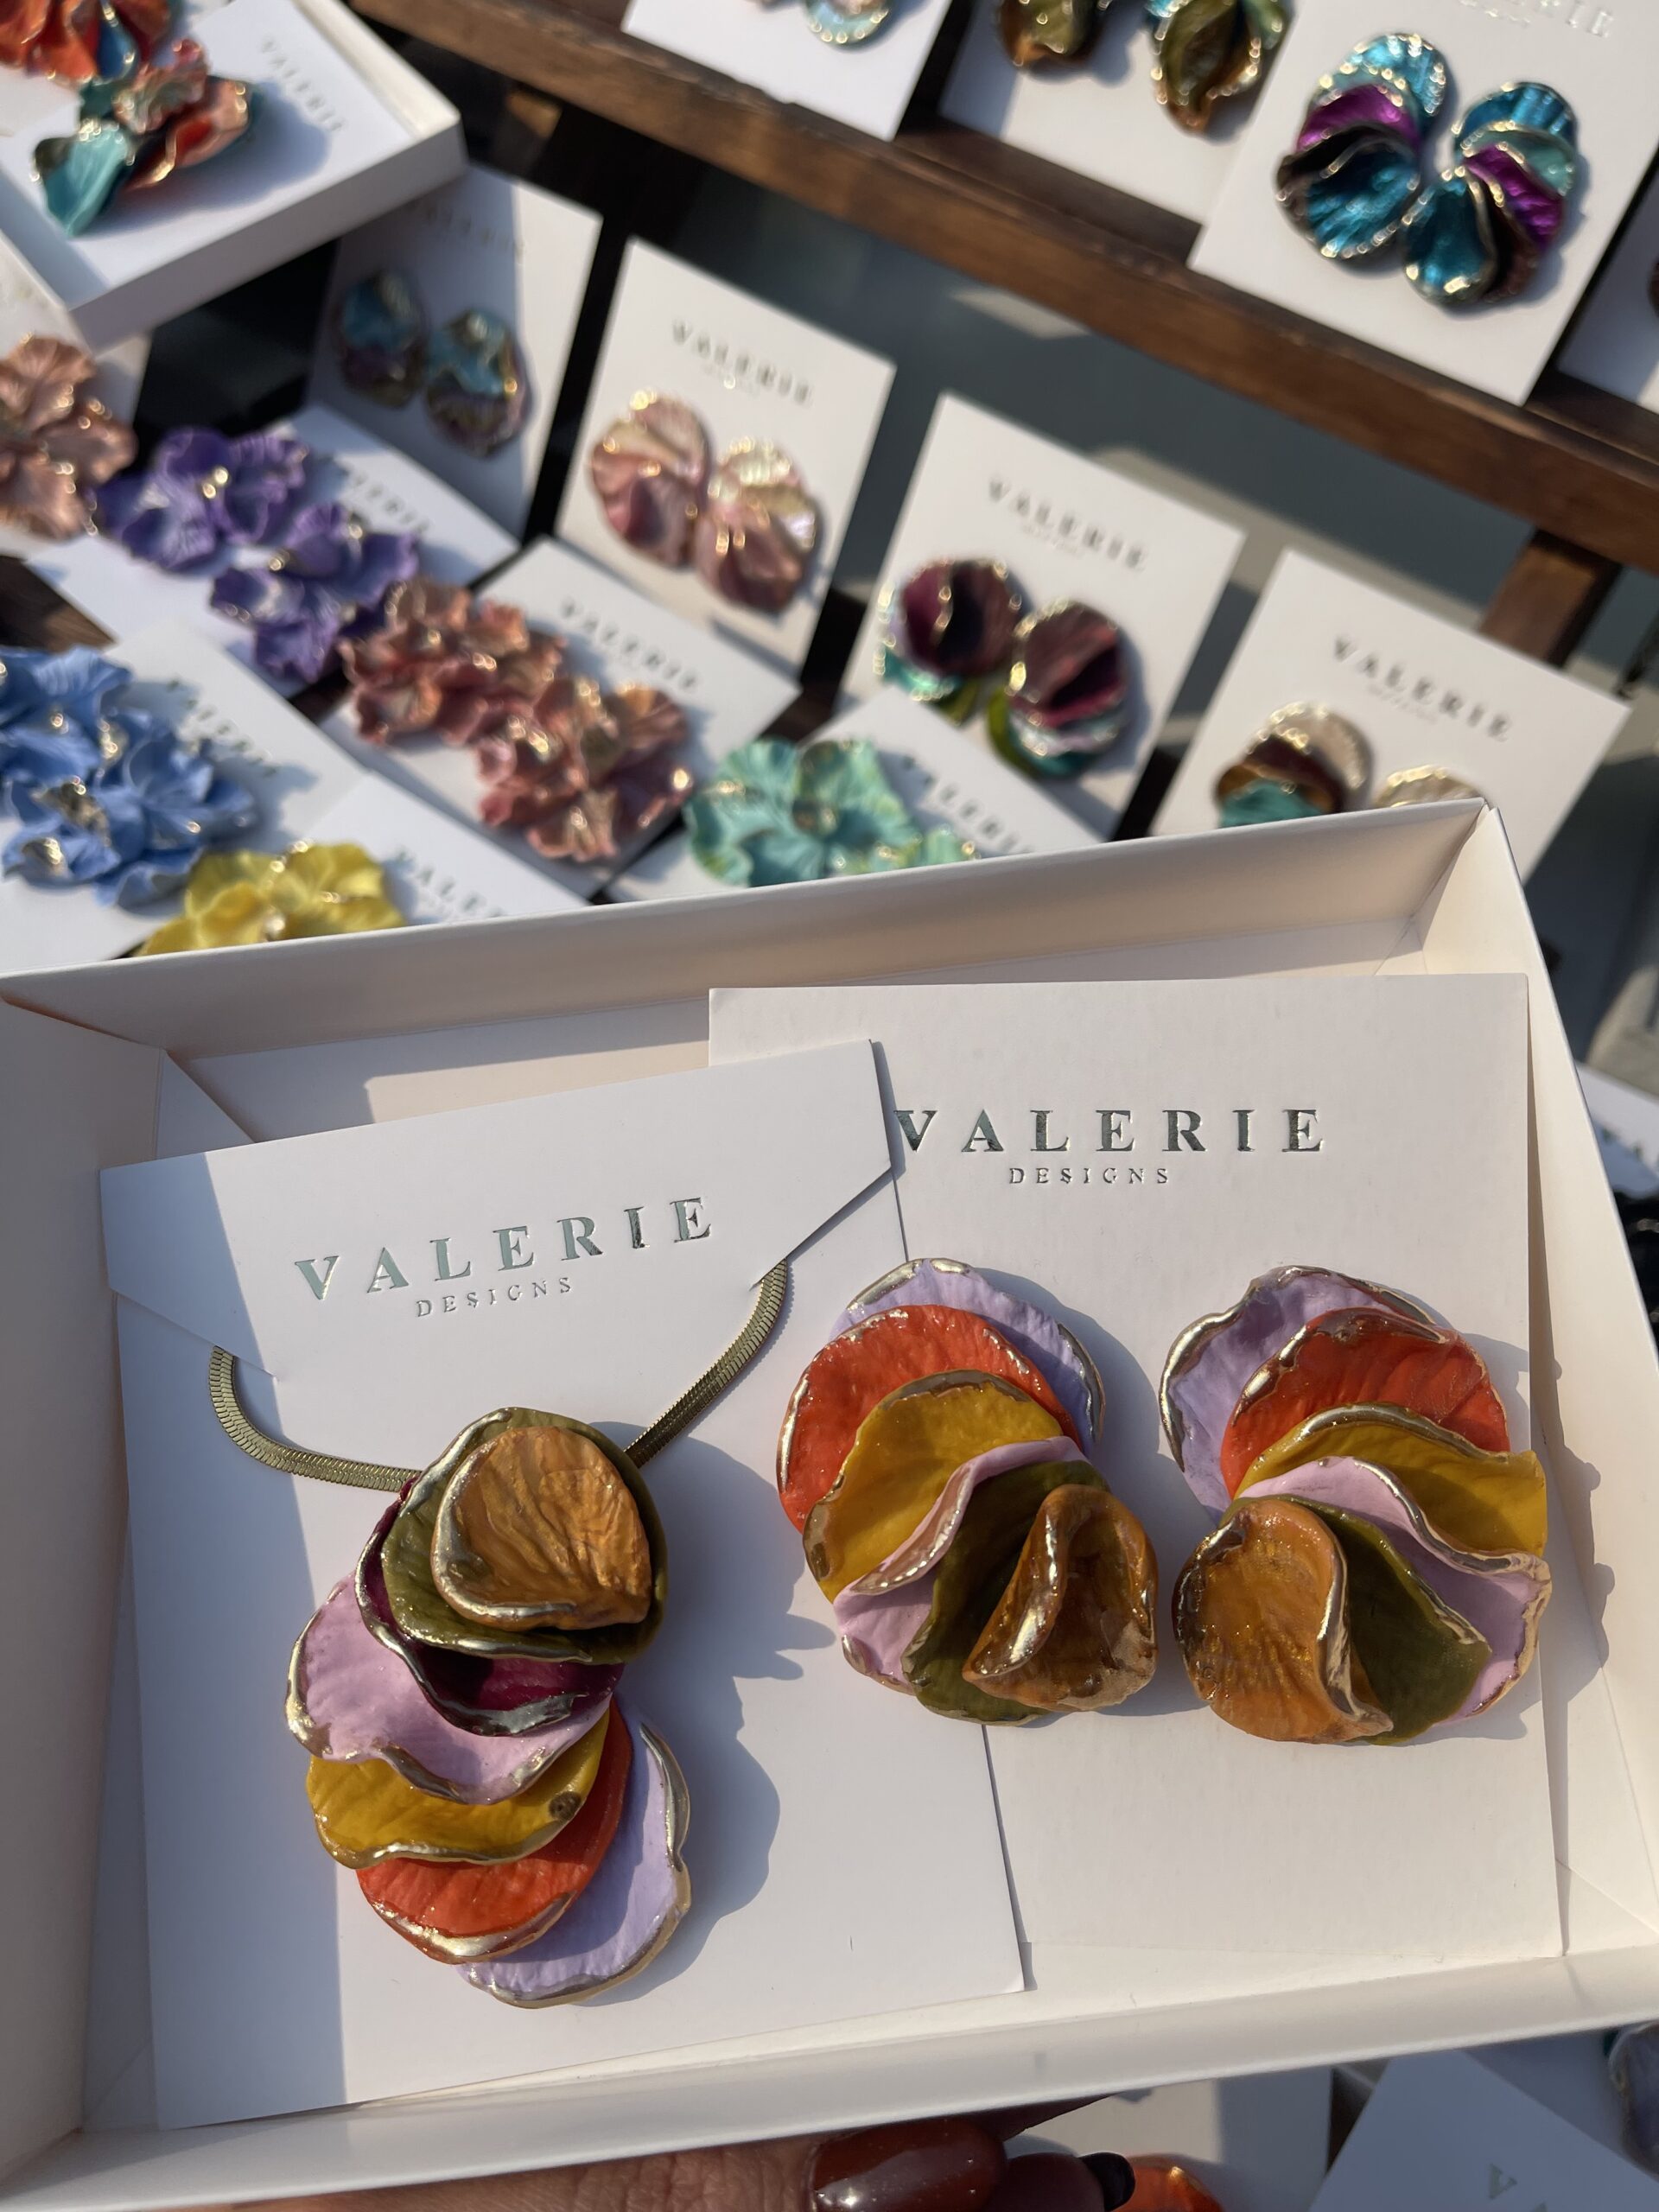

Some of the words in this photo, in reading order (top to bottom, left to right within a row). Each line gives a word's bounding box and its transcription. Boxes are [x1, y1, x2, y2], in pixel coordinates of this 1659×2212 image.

[893, 1109, 1324, 1153] VALERIE
[1008, 1167, 1170, 1185] DESIGNS
[294, 1197, 712, 1300] VALERIE
[416, 1276, 572, 1318] DESIGNS
